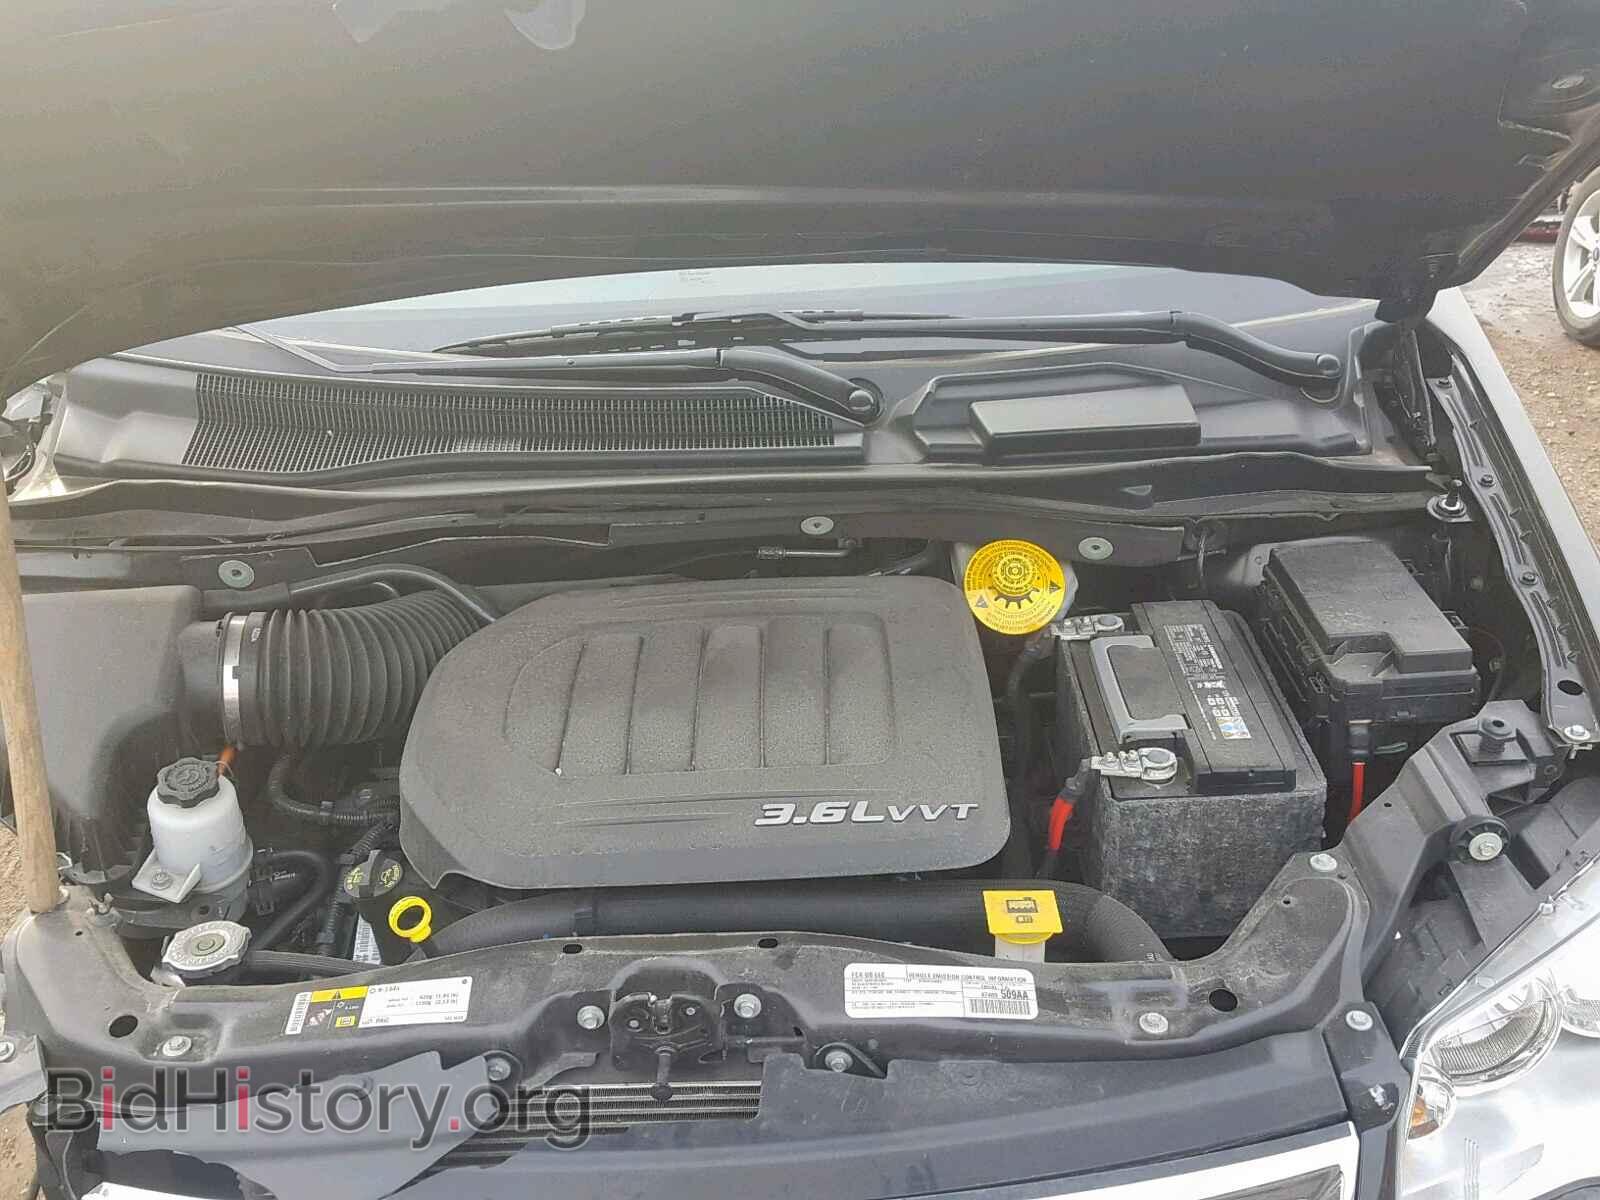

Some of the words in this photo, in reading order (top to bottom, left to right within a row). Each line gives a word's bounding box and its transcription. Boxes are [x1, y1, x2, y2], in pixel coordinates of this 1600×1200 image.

[755, 800, 884, 826] 3.6L
[887, 803, 979, 822] VVT
[1001, 990, 1029, 1000] 509AA
